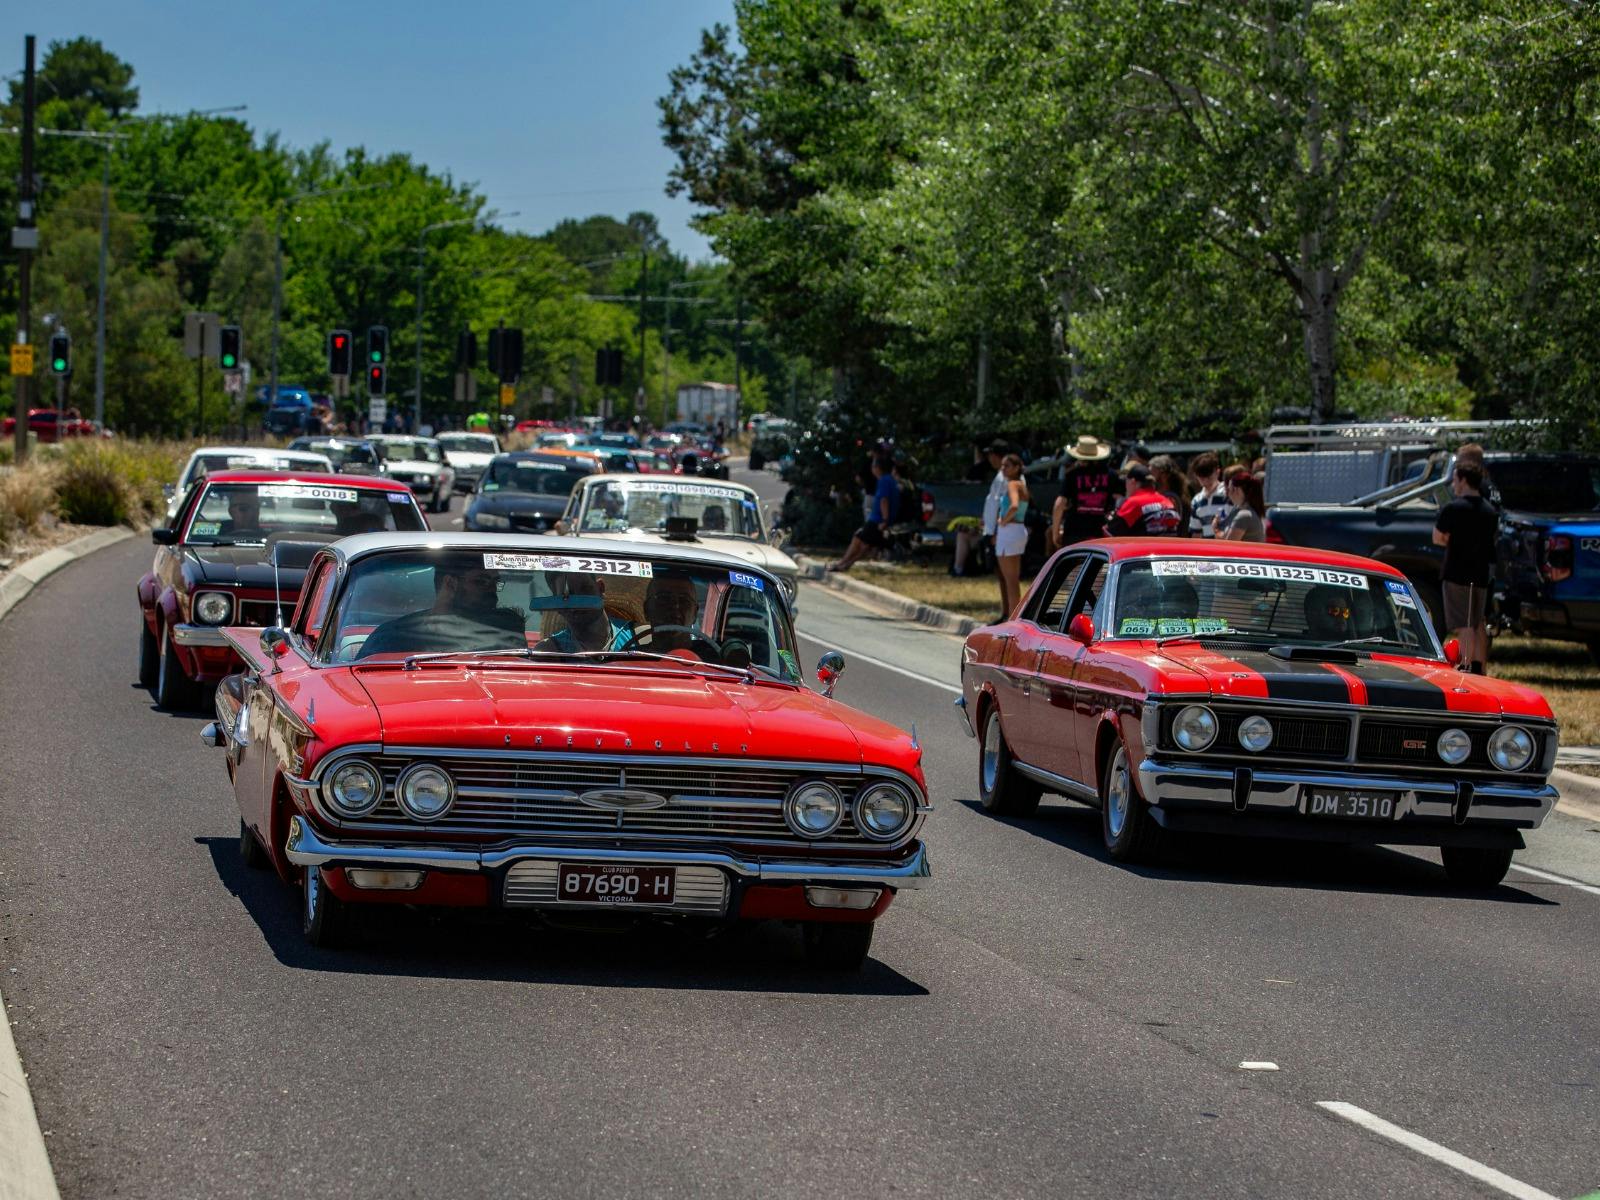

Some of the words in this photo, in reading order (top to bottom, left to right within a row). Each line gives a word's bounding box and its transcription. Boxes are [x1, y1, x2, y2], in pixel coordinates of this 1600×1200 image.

[312, 489, 348, 499] 0018
[578, 559, 633, 574] 2312
[735, 573, 759, 586] CITY
[1223, 564, 1268, 577] 0651
[1272, 567, 1315, 581] 1325
[1320, 571, 1363, 587] 1326
[504, 734, 748, 751] CHEVROLET
[598, 895, 634, 903] VICTORIA
